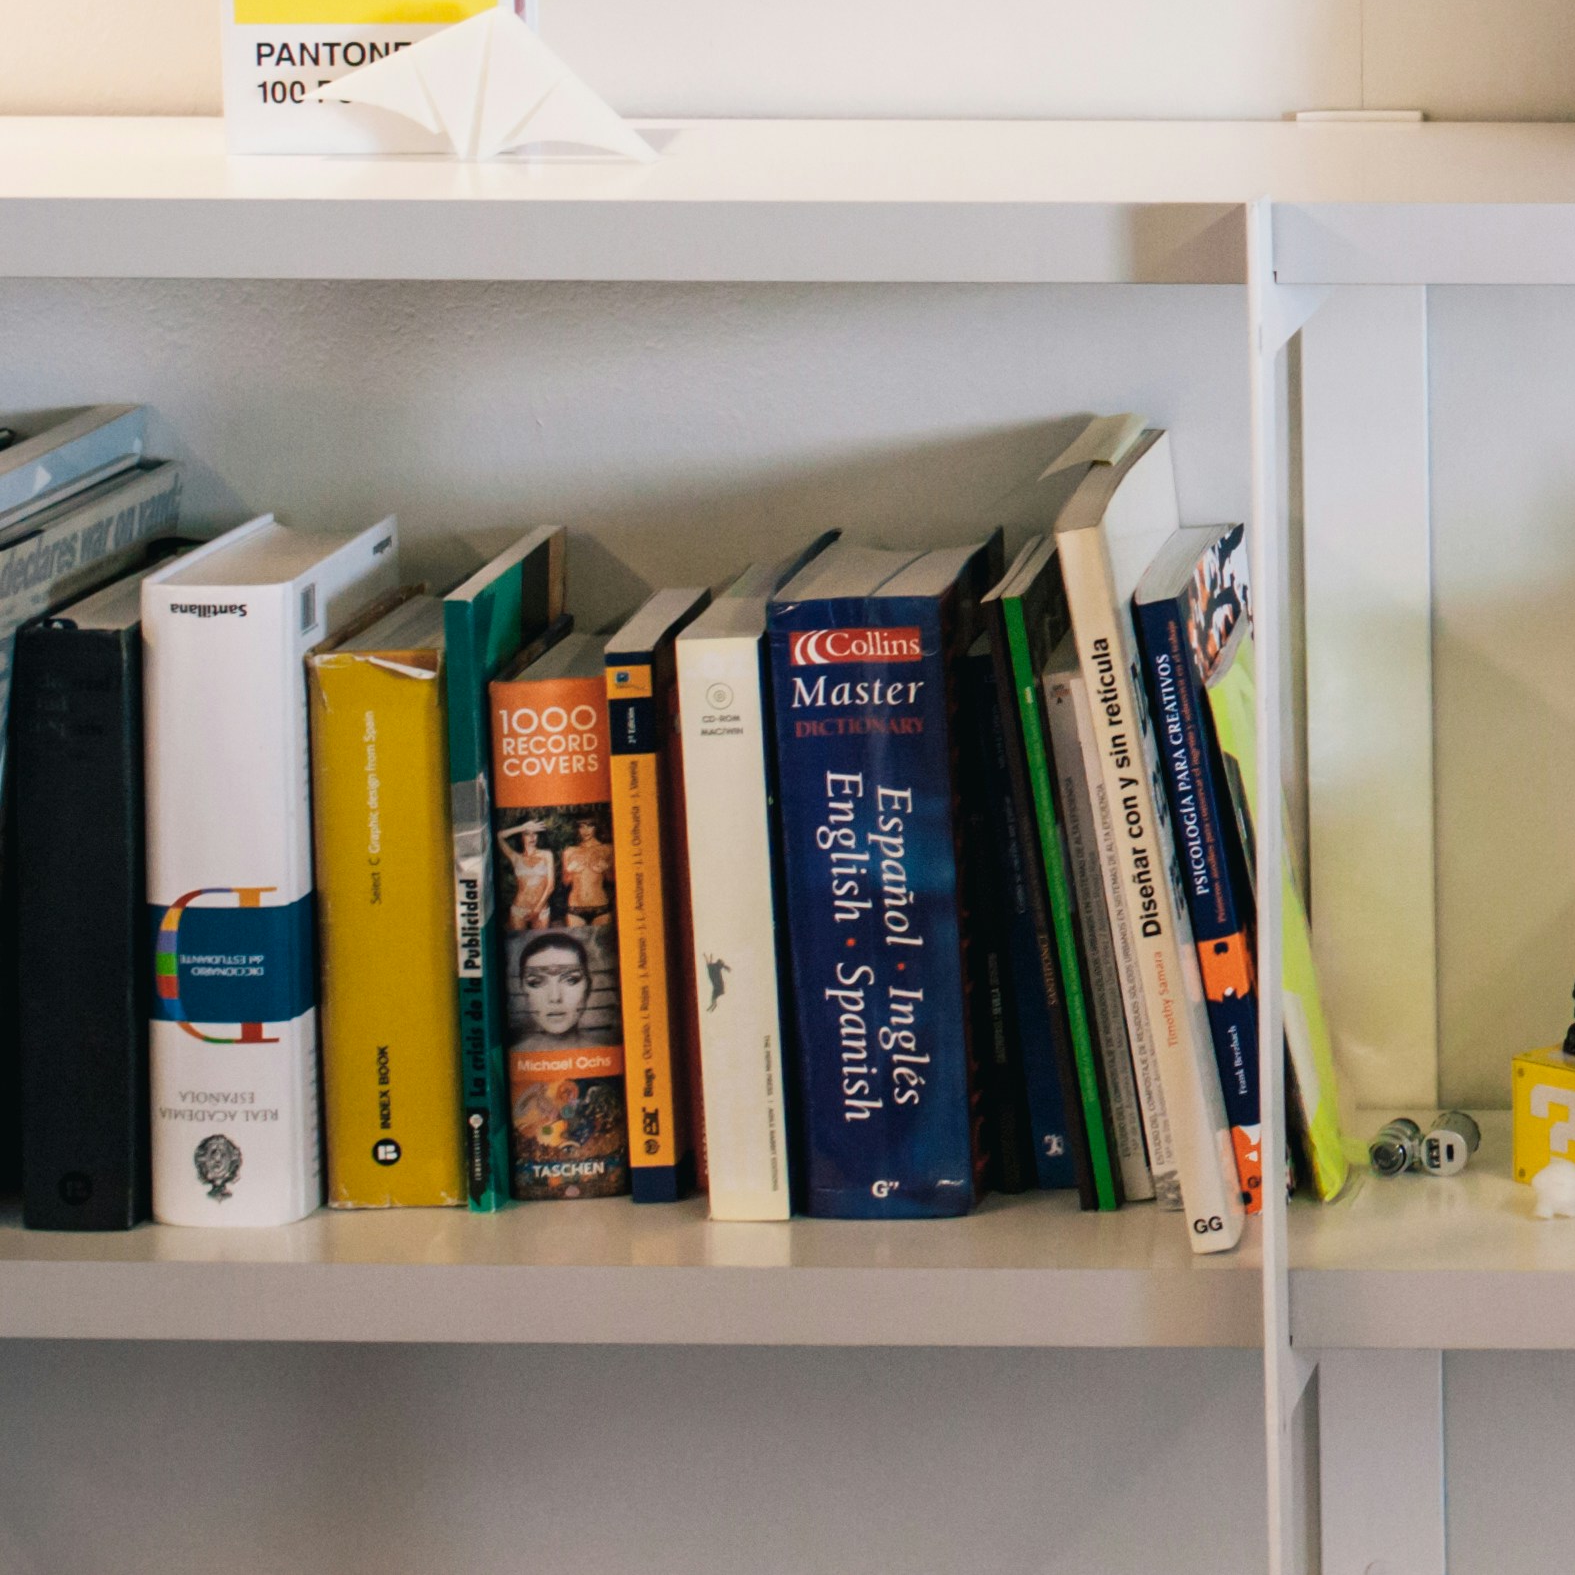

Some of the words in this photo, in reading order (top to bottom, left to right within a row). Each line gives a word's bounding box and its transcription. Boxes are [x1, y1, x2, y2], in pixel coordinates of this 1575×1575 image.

[257, 81, 305, 104] 100
[170, 603, 247, 618] Santillana
[825, 630, 922, 659] Collins
[790, 676, 925, 709] Master
[1091, 637, 1121, 726] retícula
[1155, 654, 1185, 746] CREATIVOS
[363, 711, 376, 742] Spain
[499, 705, 597, 735] 1000
[702, 714, 741, 723] CD-ROM
[795, 715, 924, 738] DICTIONARY
[365, 743, 377, 772] from
[502, 733, 598, 755] RECORD
[1110, 734, 1131, 769] sin
[503, 754, 598, 777] COVERS
[1171, 748, 1192, 792] PARA
[367, 776, 380, 809] design
[1118, 777, 1139, 792] y
[1095, 784, 1110, 831] EFICIENCIA
[1122, 796, 1144, 839] con
[368, 813, 381, 854] Graphic
[816, 770, 873, 924] English
[1104, 832, 1113, 852] ALTA
[1178, 794, 1210, 896] PSICOLOGÍA
[867, 784, 924, 947] Español
[1107, 853, 1115, 866] DE
[370, 872, 381, 905] Select
[1109, 867, 1122, 908] SISTEMAS
[1131, 847, 1162, 938] Diseñar
[459, 879, 480, 970] Publicidad
[1116, 909, 1124, 920] EN
[1118, 922, 1131, 963] URBANOS
[180, 954, 246, 964] ESTUDIANTE
[191, 966, 264, 976] DICCIONARIO
[248, 955, 264, 964] del
[1153, 951, 1170, 996] Samara
[464, 978, 482, 990] la
[1125, 964, 1137, 999] SÓLIDOS
[465, 999, 483, 1020] de
[1131, 1001, 1144, 1044] RESIDUOS
[1160, 998, 1179, 1048] Timothy
[466, 1026, 485, 1070] crisis
[825, 962, 884, 1124] Spanish
[879, 986, 931, 1106] Inglés
[1138, 1044, 1146, 1056] DE
[377, 1045, 389, 1086] BOOK
[518, 1059, 572, 1071] Michael
[576, 1056, 611, 1069] Ochs
[469, 1077, 486, 1097] La
[643, 1068, 655, 1097] Blogs
[1140, 1058, 1156, 1111] COMPOSTAJE
[1236, 1069, 1247, 1095] Frank
[179, 1091, 255, 1105] ESPAÑOLA
[380, 1090, 391, 1129] INDEX
[159, 1108, 237, 1122] ACADEMIA
[241, 1109, 279, 1122] REAL
[1150, 1114, 1158, 1129] DEL
[1152, 1130, 1164, 1164] ESTUDIO
[533, 1161, 605, 1178] TASCHEN
[1193, 1216, 1223, 1234] GG
